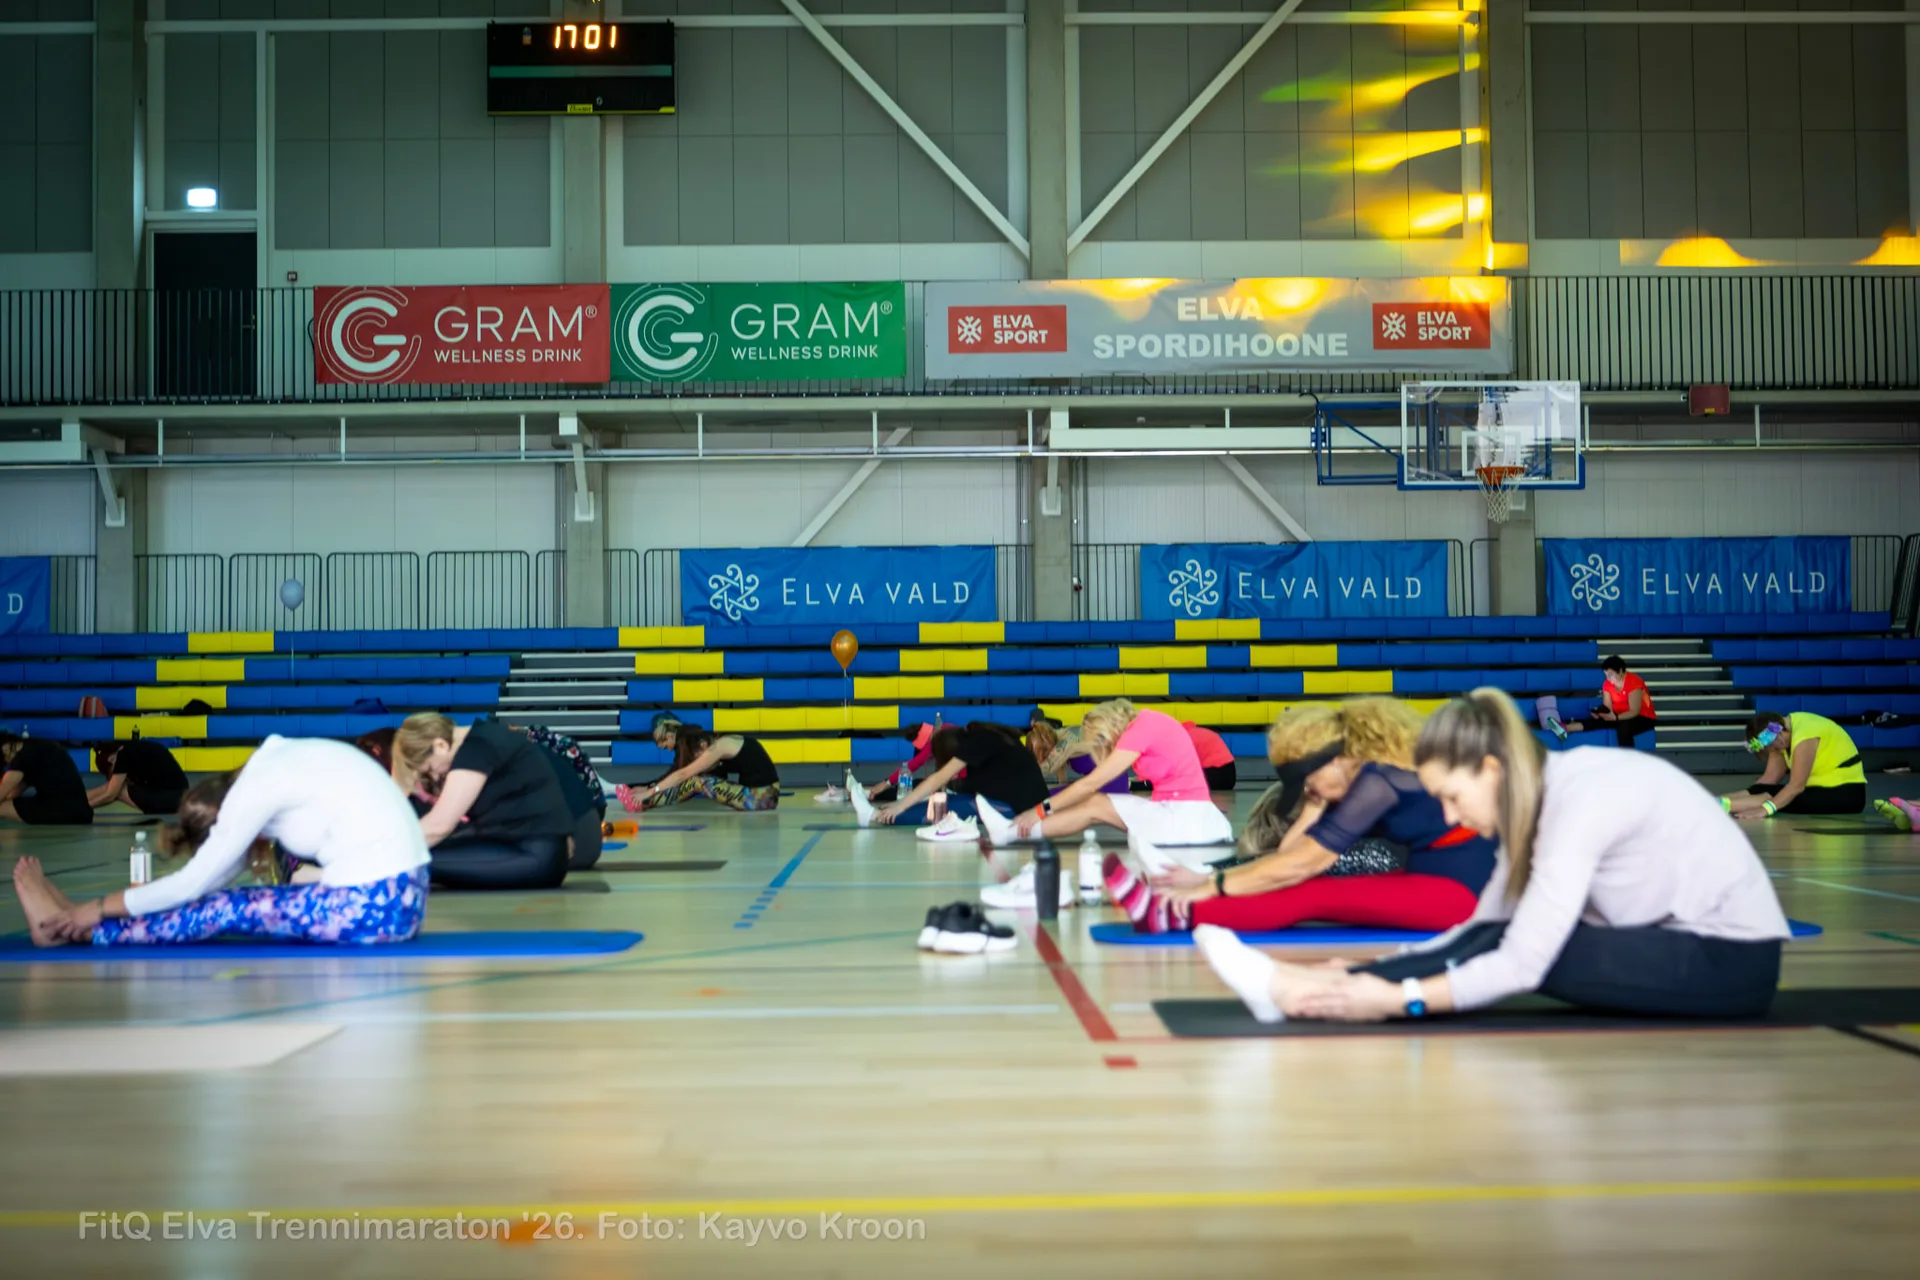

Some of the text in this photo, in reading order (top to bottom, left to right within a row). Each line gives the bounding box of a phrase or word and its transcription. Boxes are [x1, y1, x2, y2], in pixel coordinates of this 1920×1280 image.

[1177, 296, 1264, 321] ELVA
[993, 313, 1034, 329] ELVA
[1417, 311, 1458, 326] ELVA
[993, 329, 1048, 344] SPORT
[1417, 325, 1472, 341] SPORT
[731, 344, 878, 360] WELLNESS DRINK
[1092, 333, 1349, 359] SPORDIHOONE
[434, 348, 582, 363] WELLNESS DRINK
[1239, 571, 1422, 599] ELVA VALD
[1642, 568, 1825, 595] ELVA VALD
[782, 577, 970, 605] ELVA VALD
